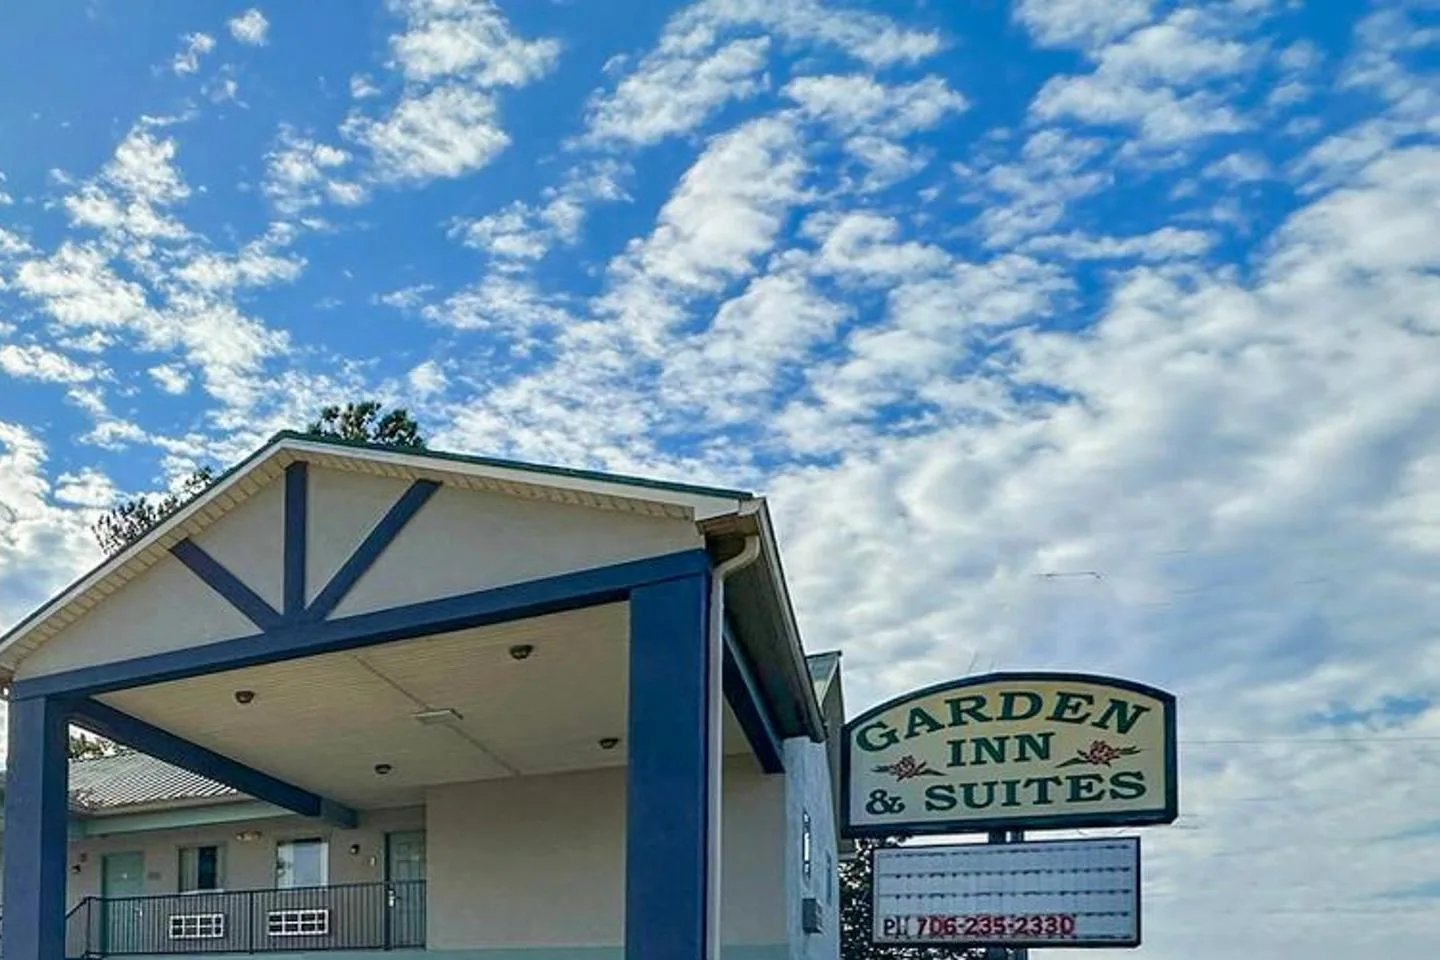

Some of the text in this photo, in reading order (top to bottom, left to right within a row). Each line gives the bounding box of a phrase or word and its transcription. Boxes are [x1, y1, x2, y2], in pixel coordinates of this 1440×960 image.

[855, 691, 1151, 752] GARDEN
[946, 732, 1056, 768] INN
[864, 771, 1147, 815] & SUITES
[917, 915, 1076, 937] 706-235-2330
